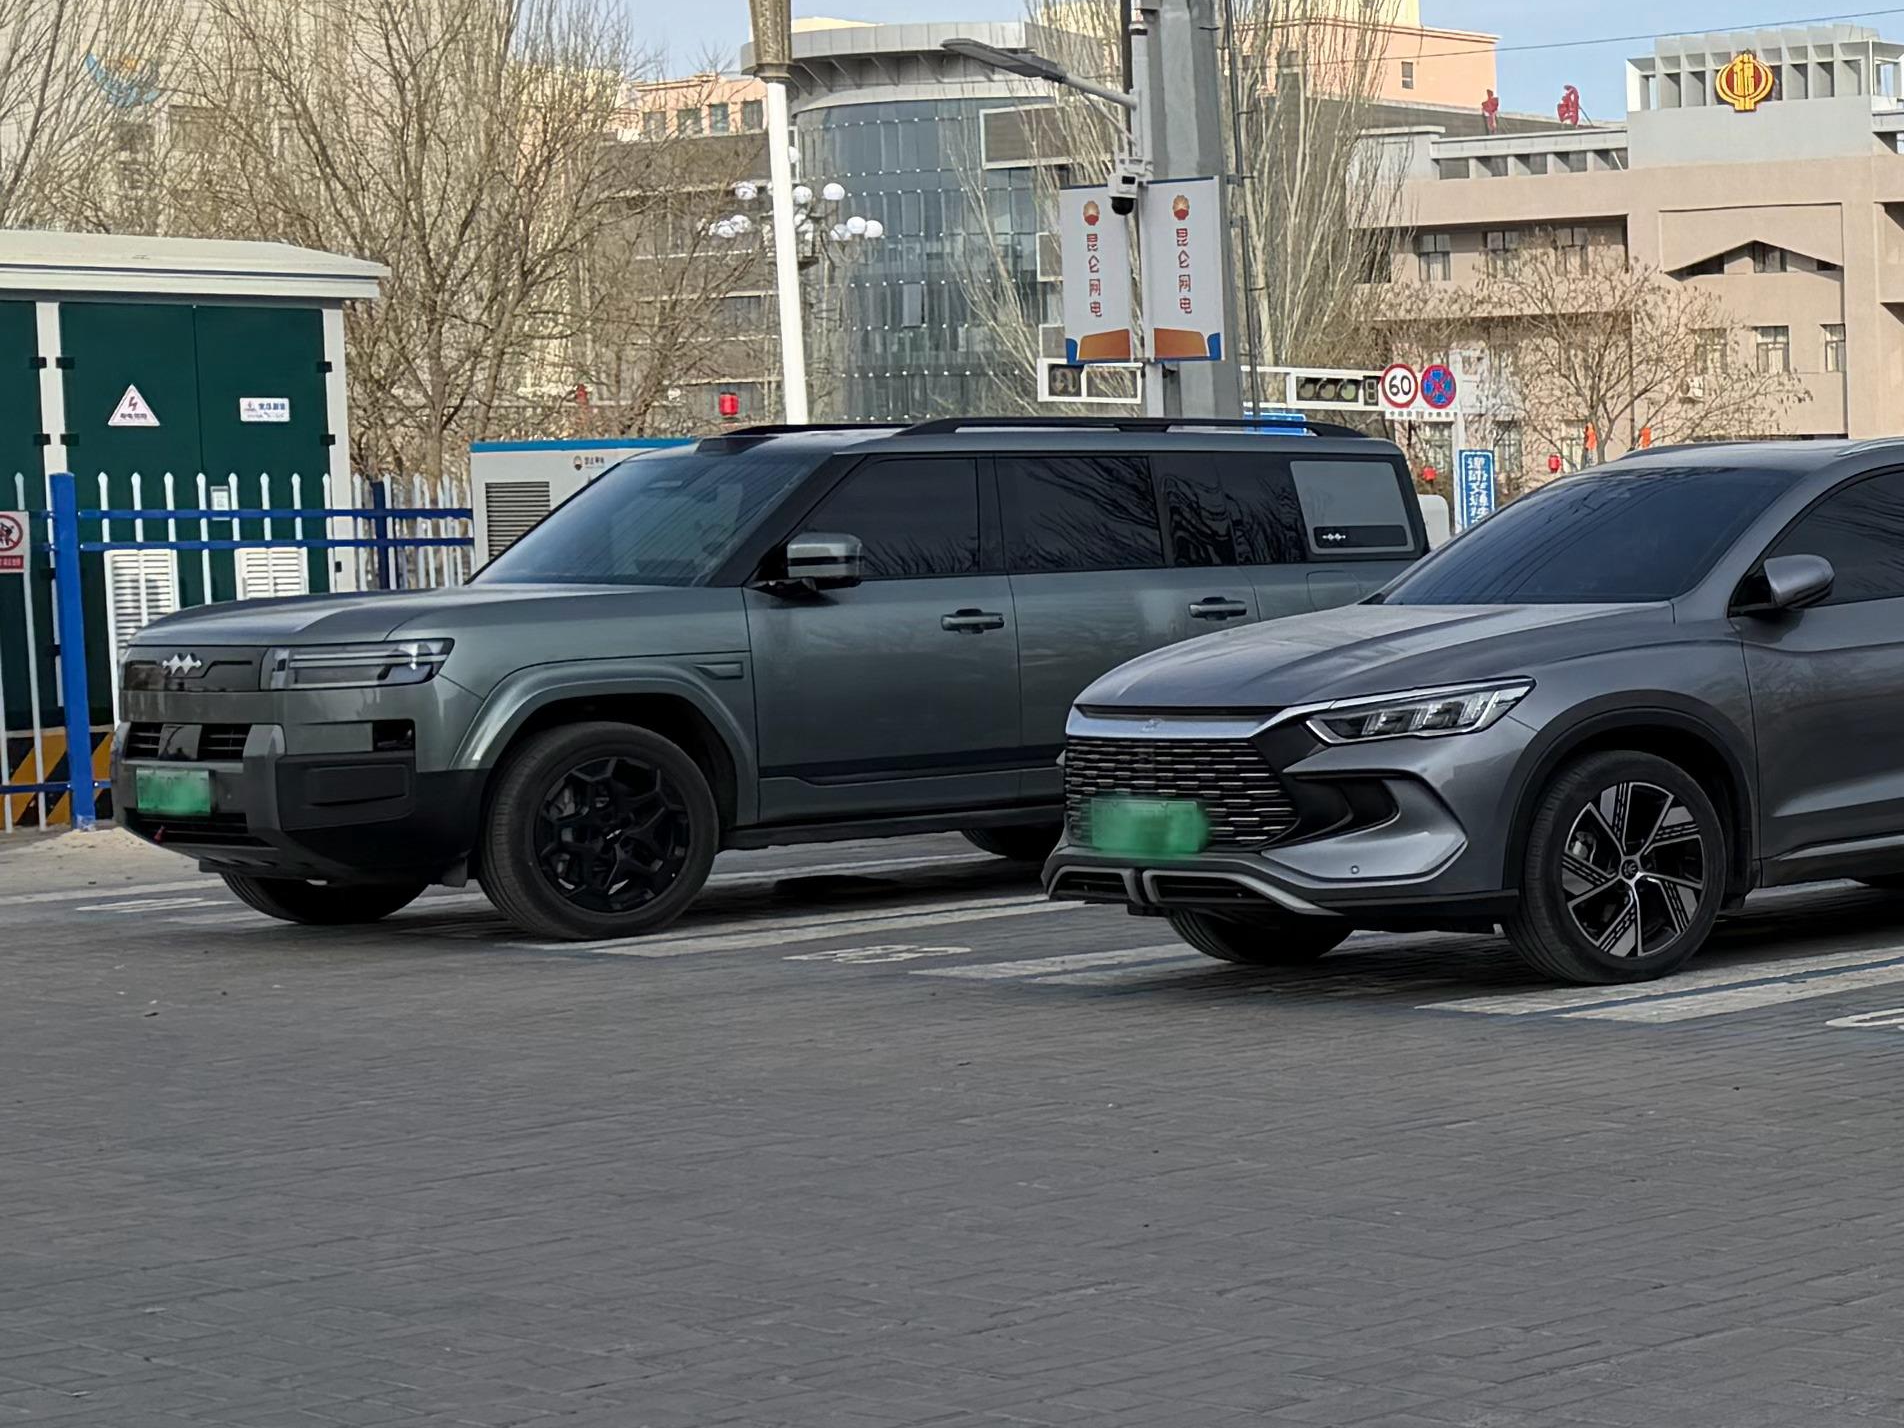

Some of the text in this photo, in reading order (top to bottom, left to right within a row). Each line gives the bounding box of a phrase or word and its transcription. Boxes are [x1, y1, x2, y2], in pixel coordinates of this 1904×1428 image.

[1086, 233, 1103, 317] 昆仑网电
[1176, 227, 1193, 314] 昆仑网电
[1388, 375, 1412, 396] 60
